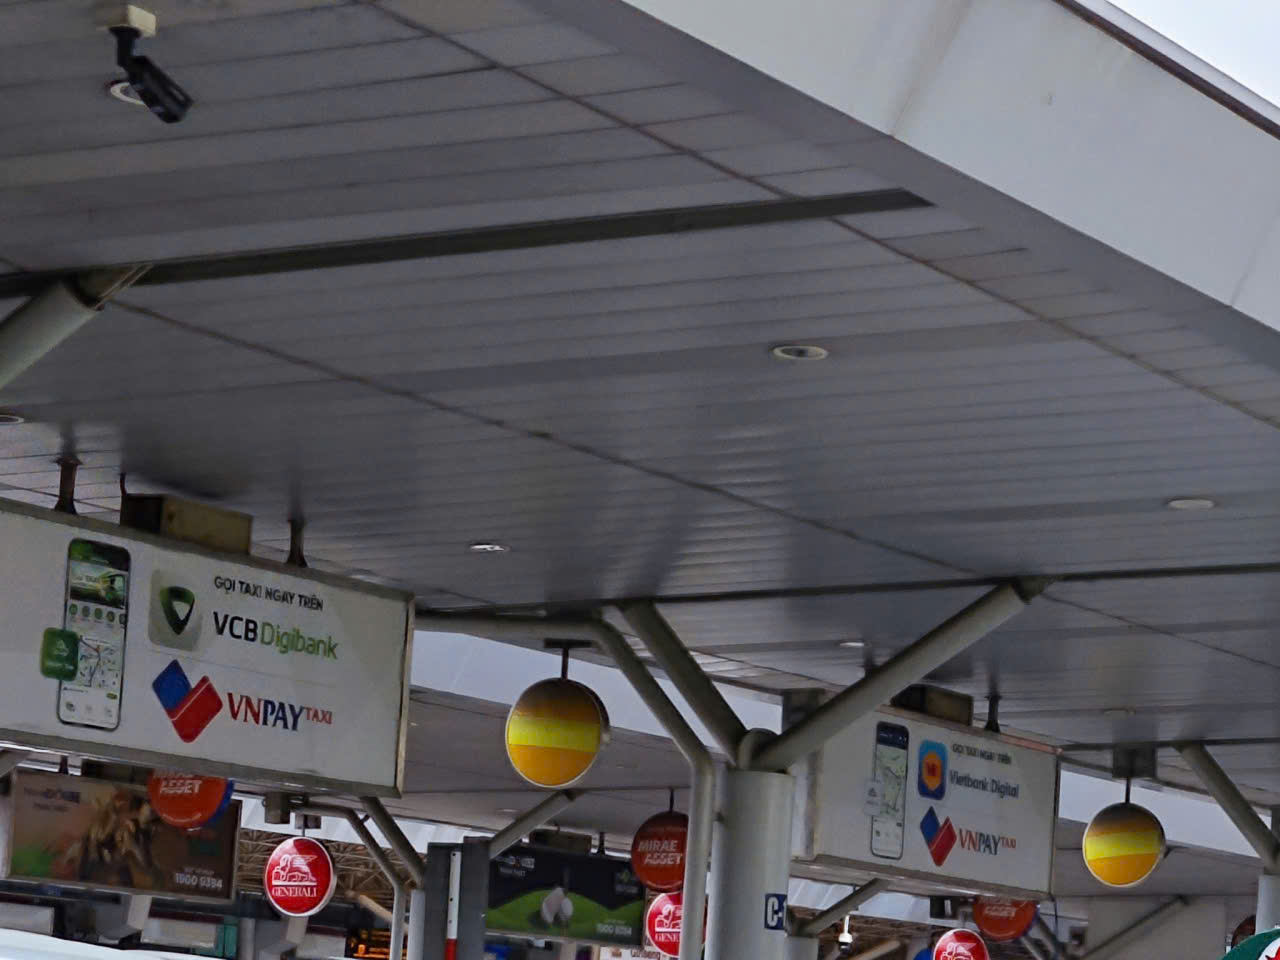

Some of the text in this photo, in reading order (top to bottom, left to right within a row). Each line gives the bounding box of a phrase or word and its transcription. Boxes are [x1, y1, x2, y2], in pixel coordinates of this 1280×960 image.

[214, 576, 324, 611] GỌI TAXI NGAY TRÊN
[638, 840, 679, 852] MIRAE
[645, 852, 683, 865] ASSET
[272, 887, 317, 897] GENERALI
[655, 932, 681, 943] GENE
